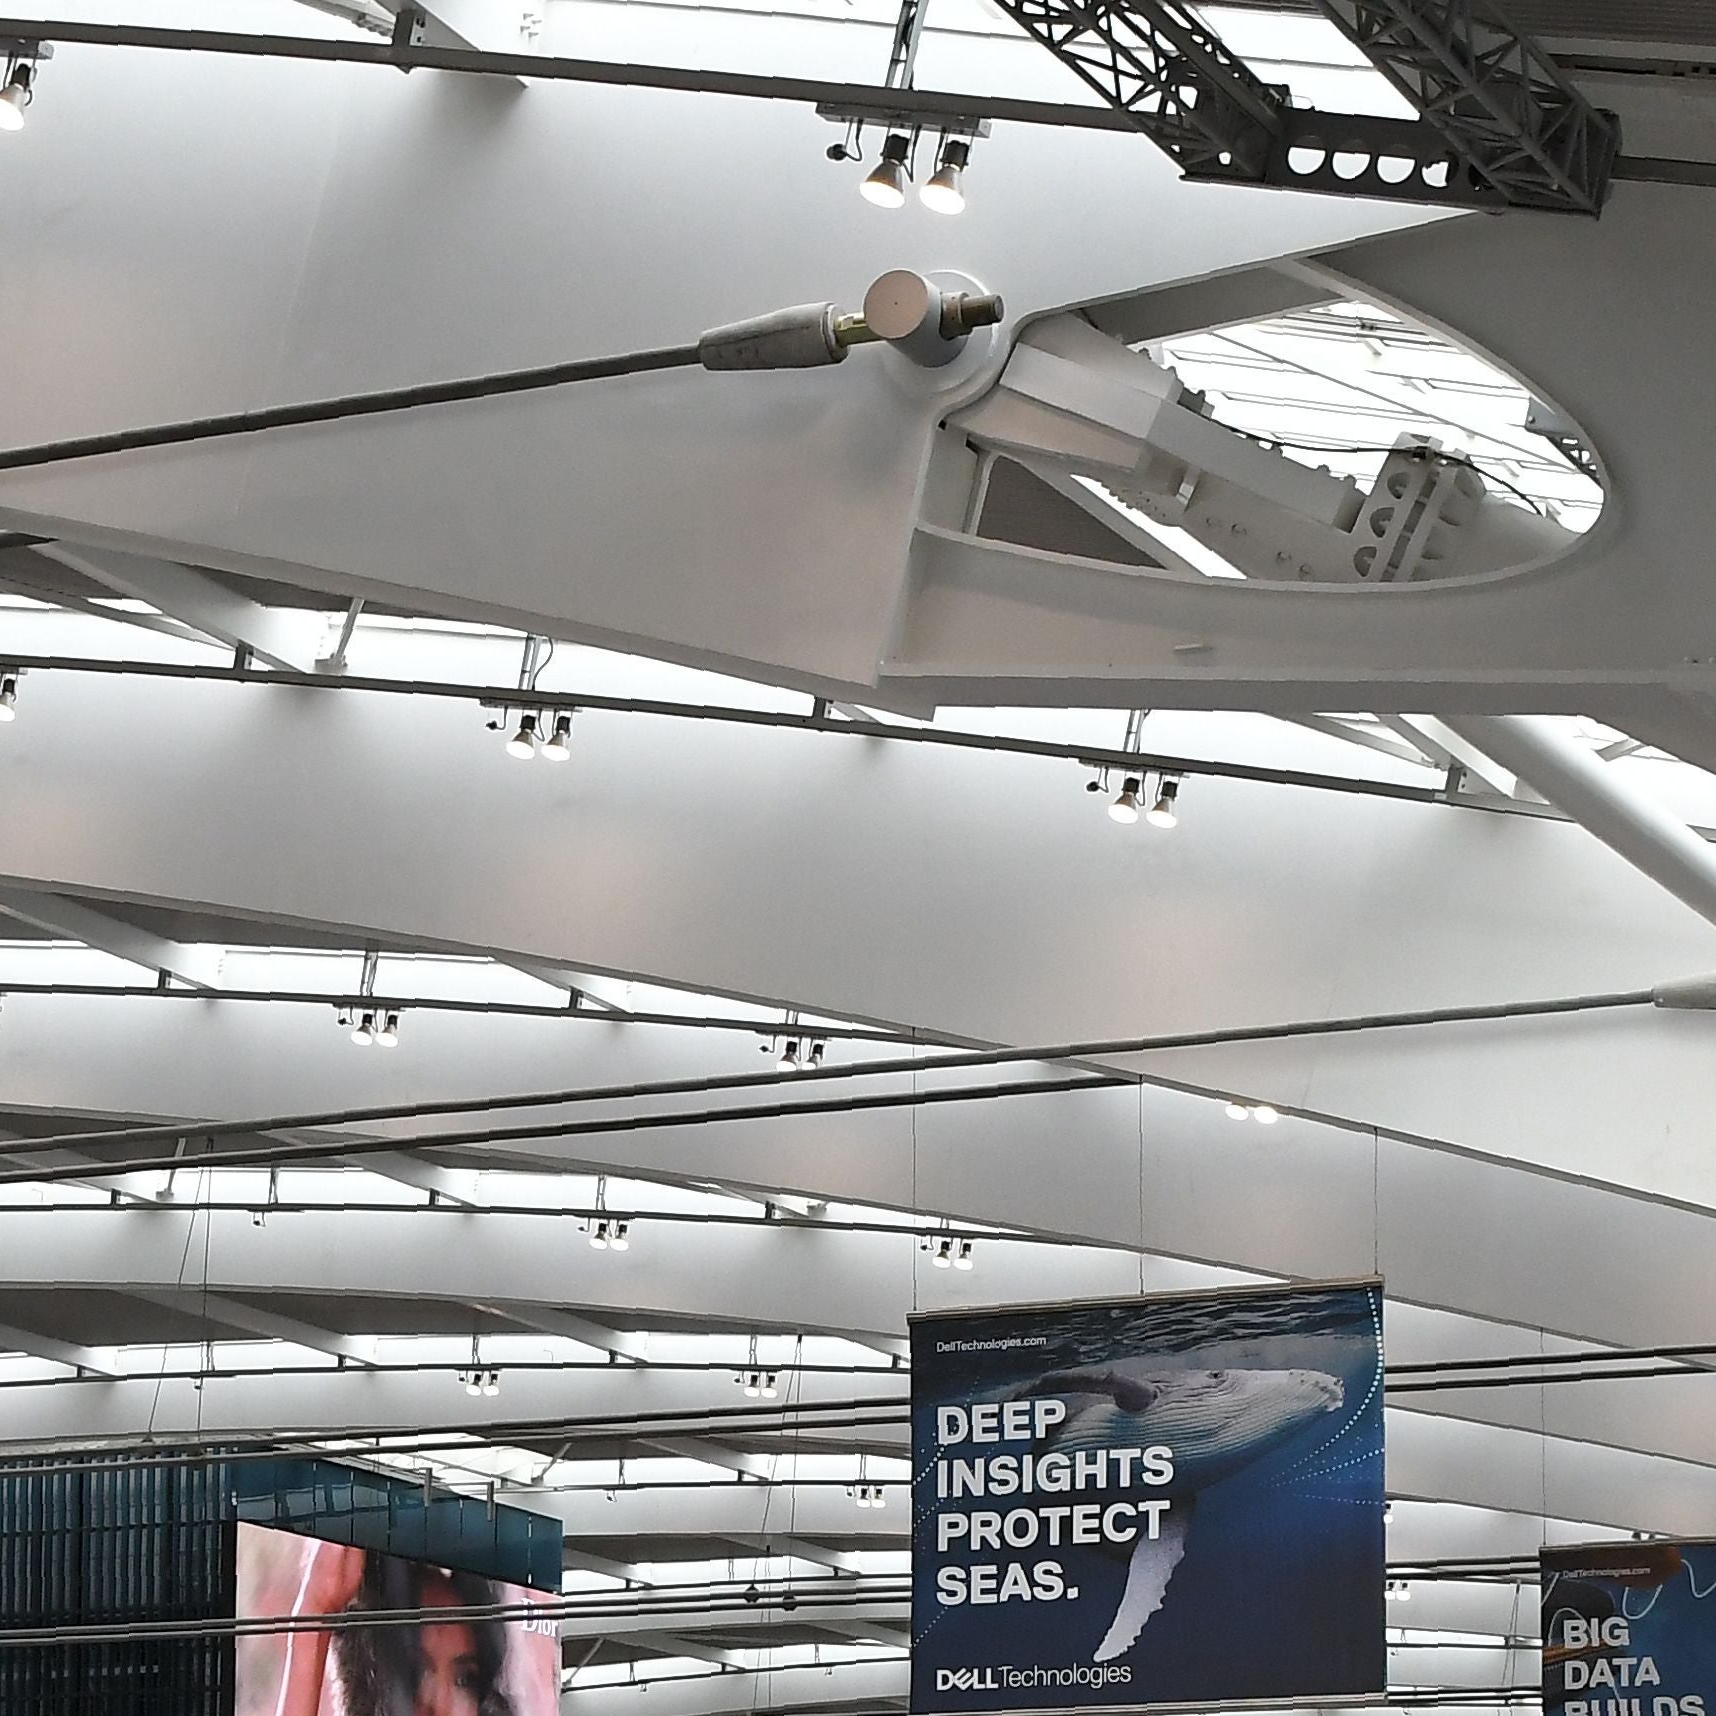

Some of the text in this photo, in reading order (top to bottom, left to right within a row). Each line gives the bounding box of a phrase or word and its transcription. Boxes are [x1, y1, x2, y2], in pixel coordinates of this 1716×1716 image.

[936, 1336, 1047, 1353] DellTechnologies.com
[936, 1399, 1066, 1446] DEEP
[936, 1446, 1174, 1499] INSIGHTS
[936, 1500, 1171, 1552] PROTECT
[936, 1561, 1080, 1607] SEAS.
[1563, 1566, 1651, 1579] DellTechnologies.com
[1563, 1617, 1629, 1649] BIG
[999, 1663, 1132, 1690] Technologies
[1564, 1656, 1660, 1690] DATA
